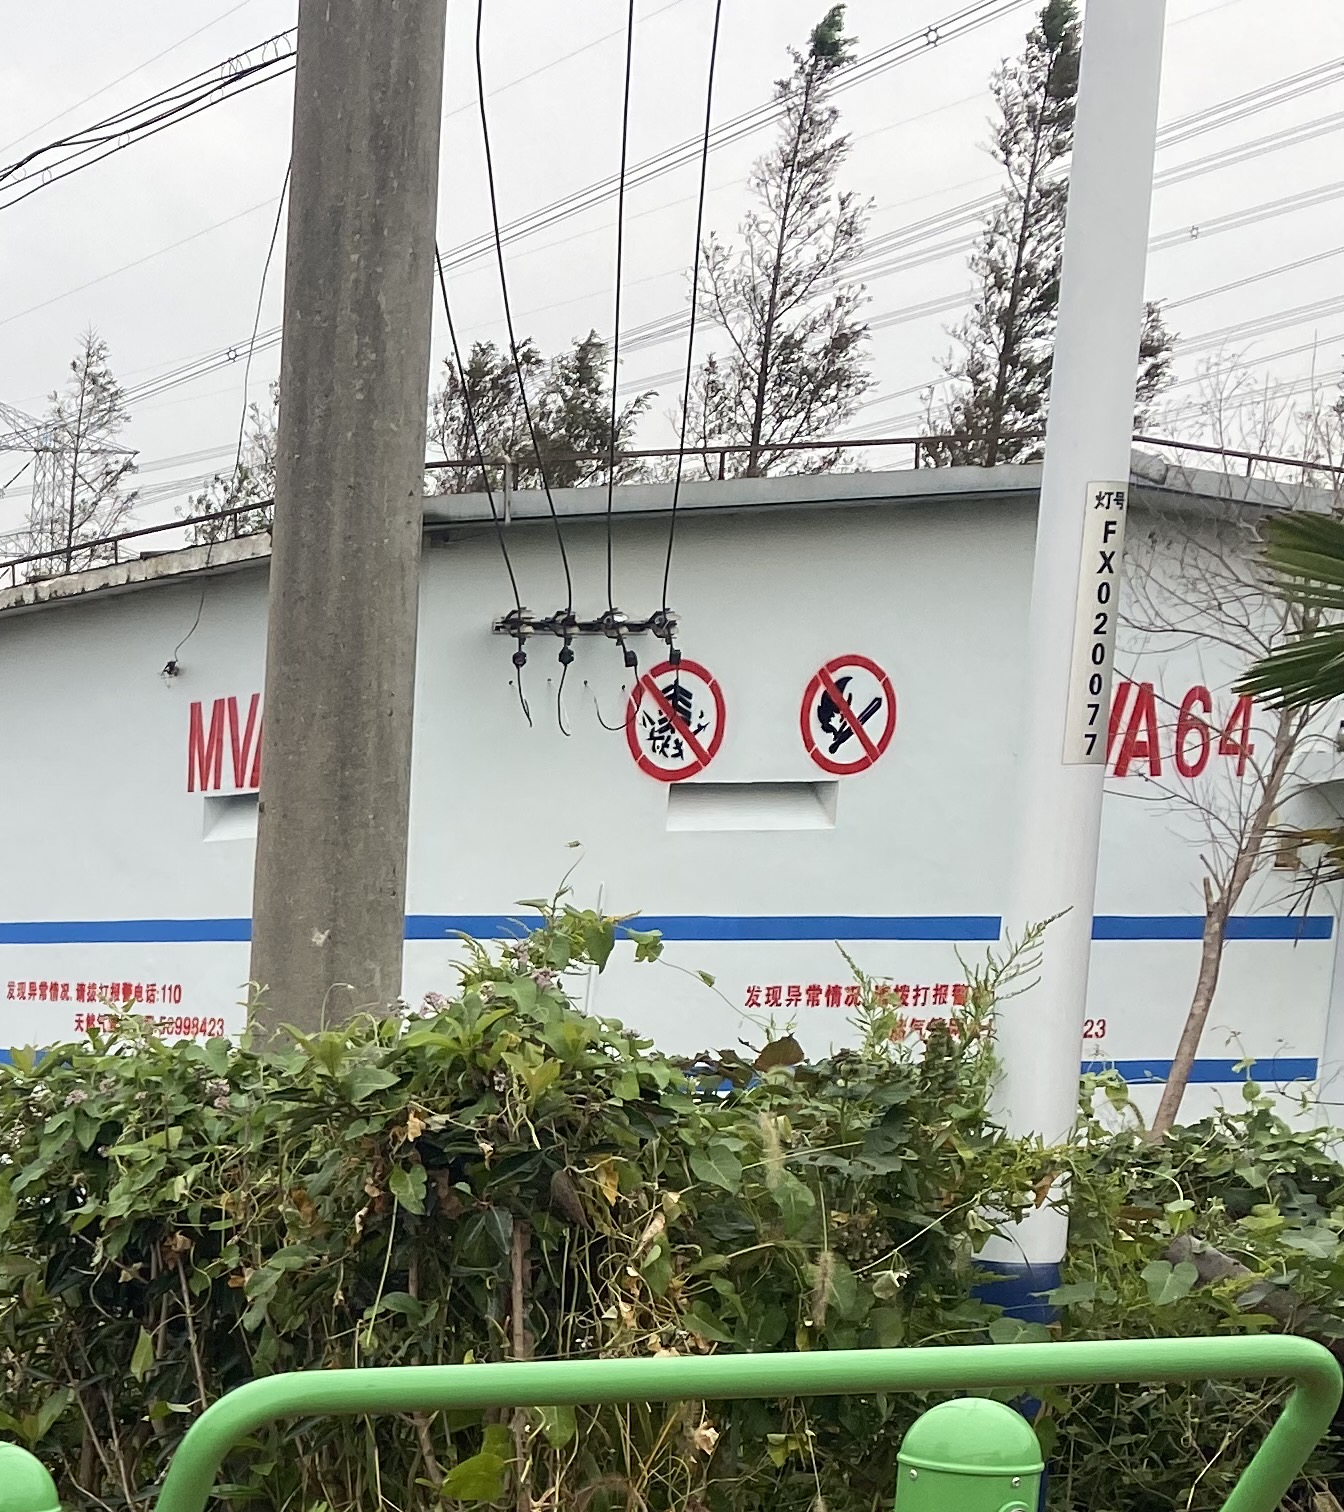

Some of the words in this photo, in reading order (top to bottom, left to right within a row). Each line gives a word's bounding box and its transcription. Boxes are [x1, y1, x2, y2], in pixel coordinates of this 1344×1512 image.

[1093, 490, 1126, 511] 灯号
[1083, 520, 1118, 756] FX020077
[187, 693, 263, 792] MV
